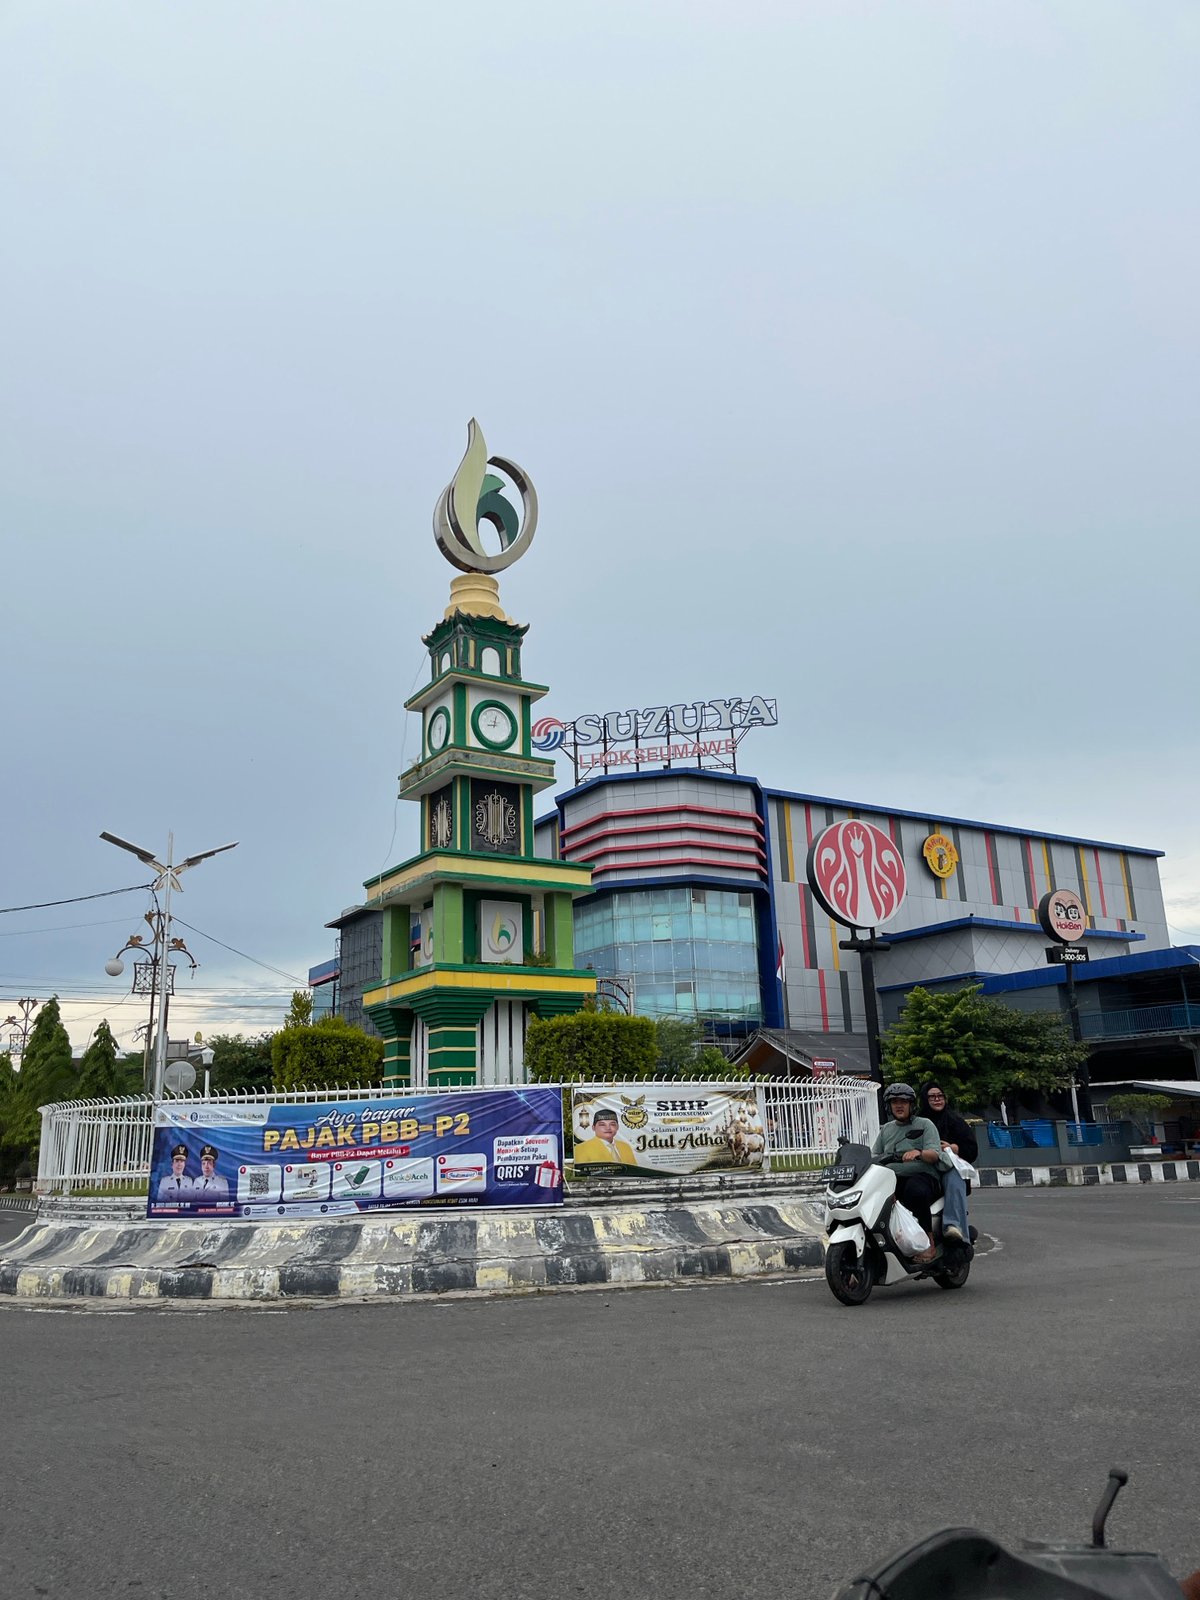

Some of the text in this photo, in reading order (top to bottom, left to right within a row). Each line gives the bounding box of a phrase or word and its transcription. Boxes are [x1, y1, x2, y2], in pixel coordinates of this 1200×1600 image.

[574, 695, 778, 746] SUZUYA
[579, 738, 737, 769] LHOKSEUMAWE
[1055, 921, 1082, 931] HokBen
[656, 1100, 709, 1111] SHIP
[314, 1106, 415, 1127] Ayo bayar
[263, 1112, 470, 1151] PAJAK PBB-P2
[497, 1139, 524, 1147] Dapatkan
[678, 1132, 727, 1150] Adha
[521, 1146, 539, 1154] Setiap
[497, 1153, 548, 1162] Pembayaran Pakai
